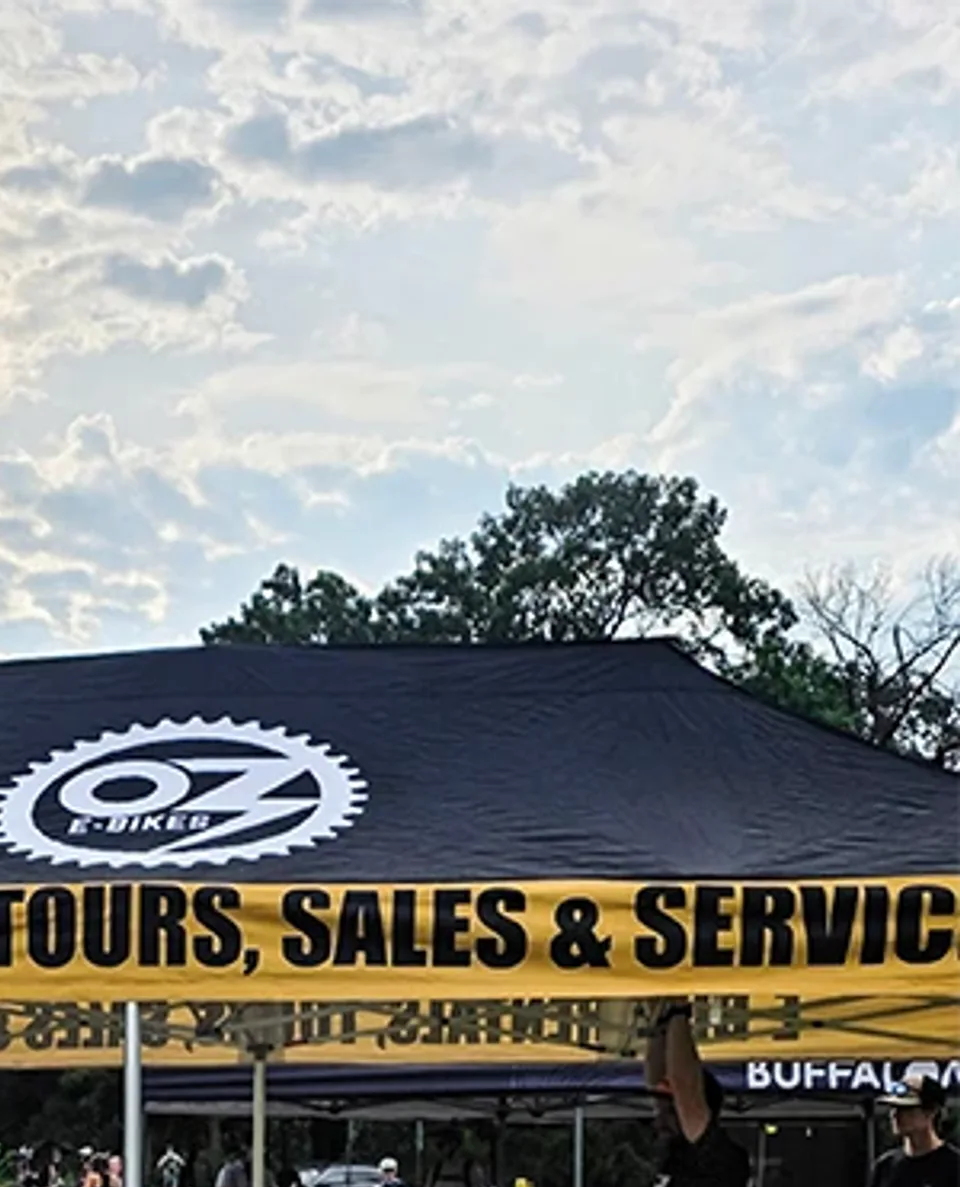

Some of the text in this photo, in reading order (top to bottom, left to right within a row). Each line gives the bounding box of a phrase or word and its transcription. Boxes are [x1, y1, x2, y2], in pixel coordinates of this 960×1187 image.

[59, 757, 323, 818] OZ
[281, 889, 527, 968] SALES
[550, 897, 611, 968] &
[634, 885, 960, 968] SERVIC
